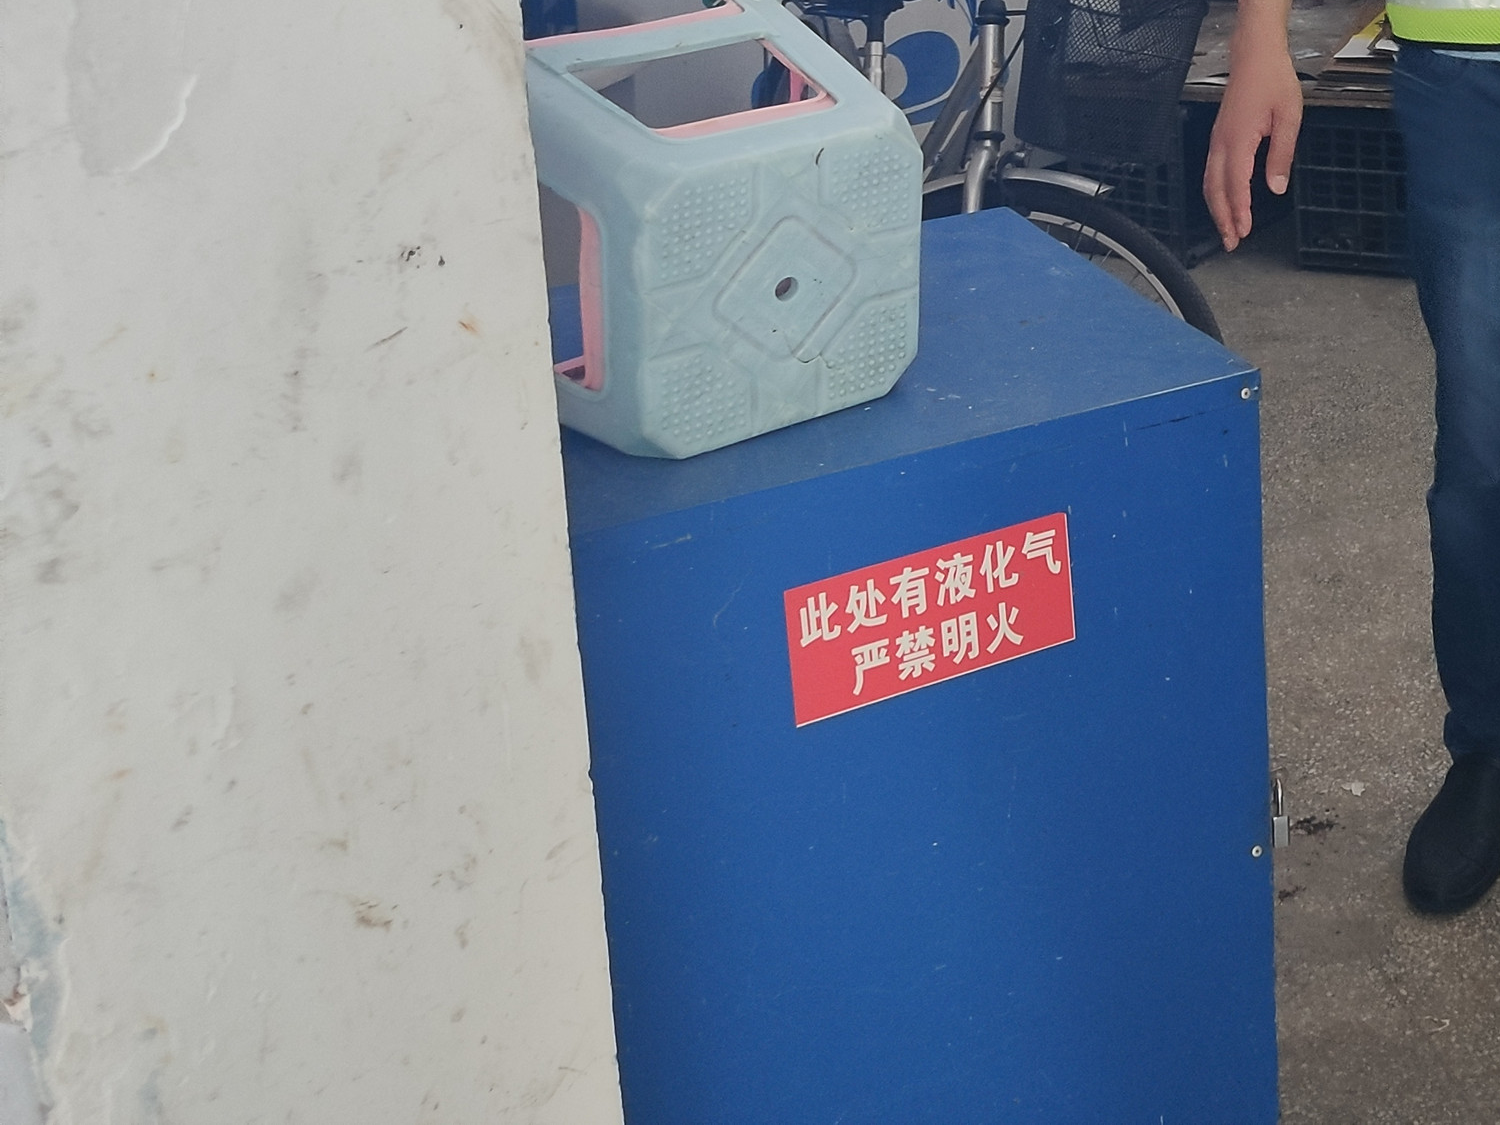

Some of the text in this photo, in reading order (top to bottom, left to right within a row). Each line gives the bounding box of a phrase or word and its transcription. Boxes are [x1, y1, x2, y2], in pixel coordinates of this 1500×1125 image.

[800, 529, 1061, 647] 此处有液化气
[851, 602, 1024, 695] 严禁明火
